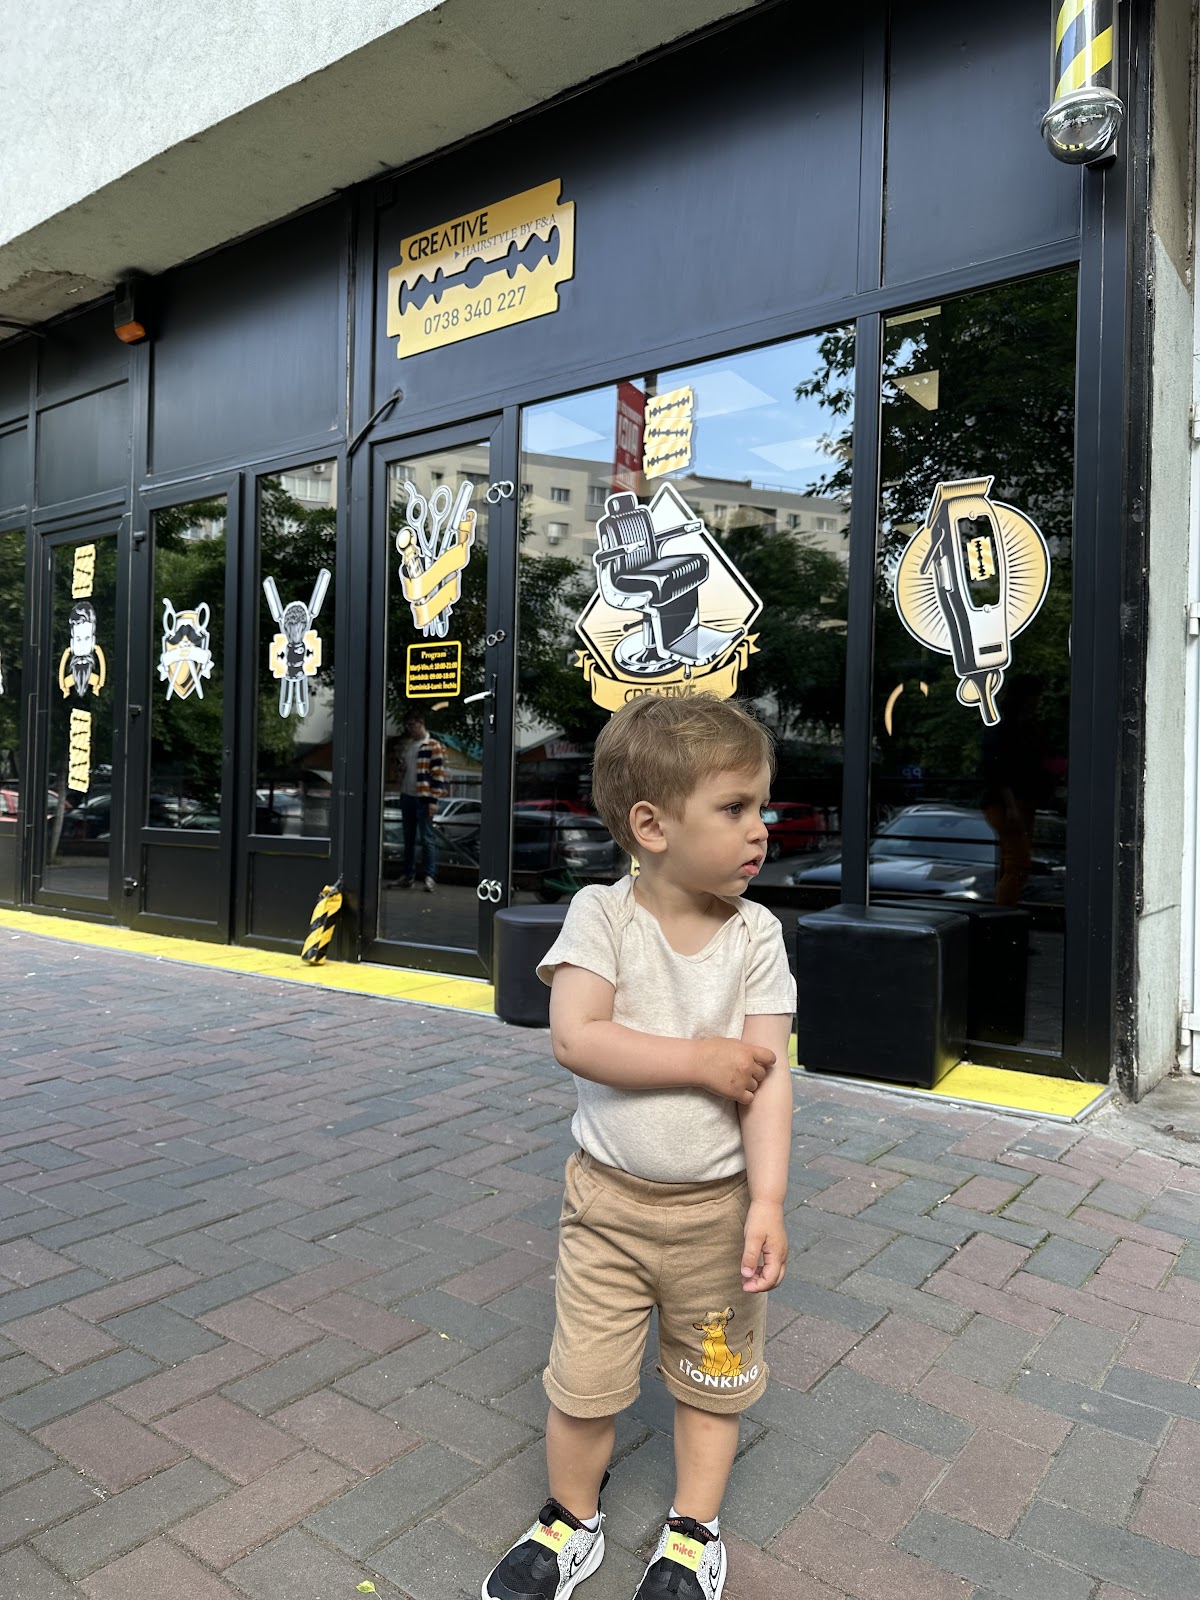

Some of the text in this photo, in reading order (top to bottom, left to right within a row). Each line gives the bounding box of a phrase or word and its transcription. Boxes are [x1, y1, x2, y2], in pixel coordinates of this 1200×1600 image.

[408, 211, 489, 261] CREATIVE
[462, 213, 557, 258] HAIRSTYLE BY F&A
[424, 285, 527, 335] 0738 340 227
[421, 651, 447, 661] Program
